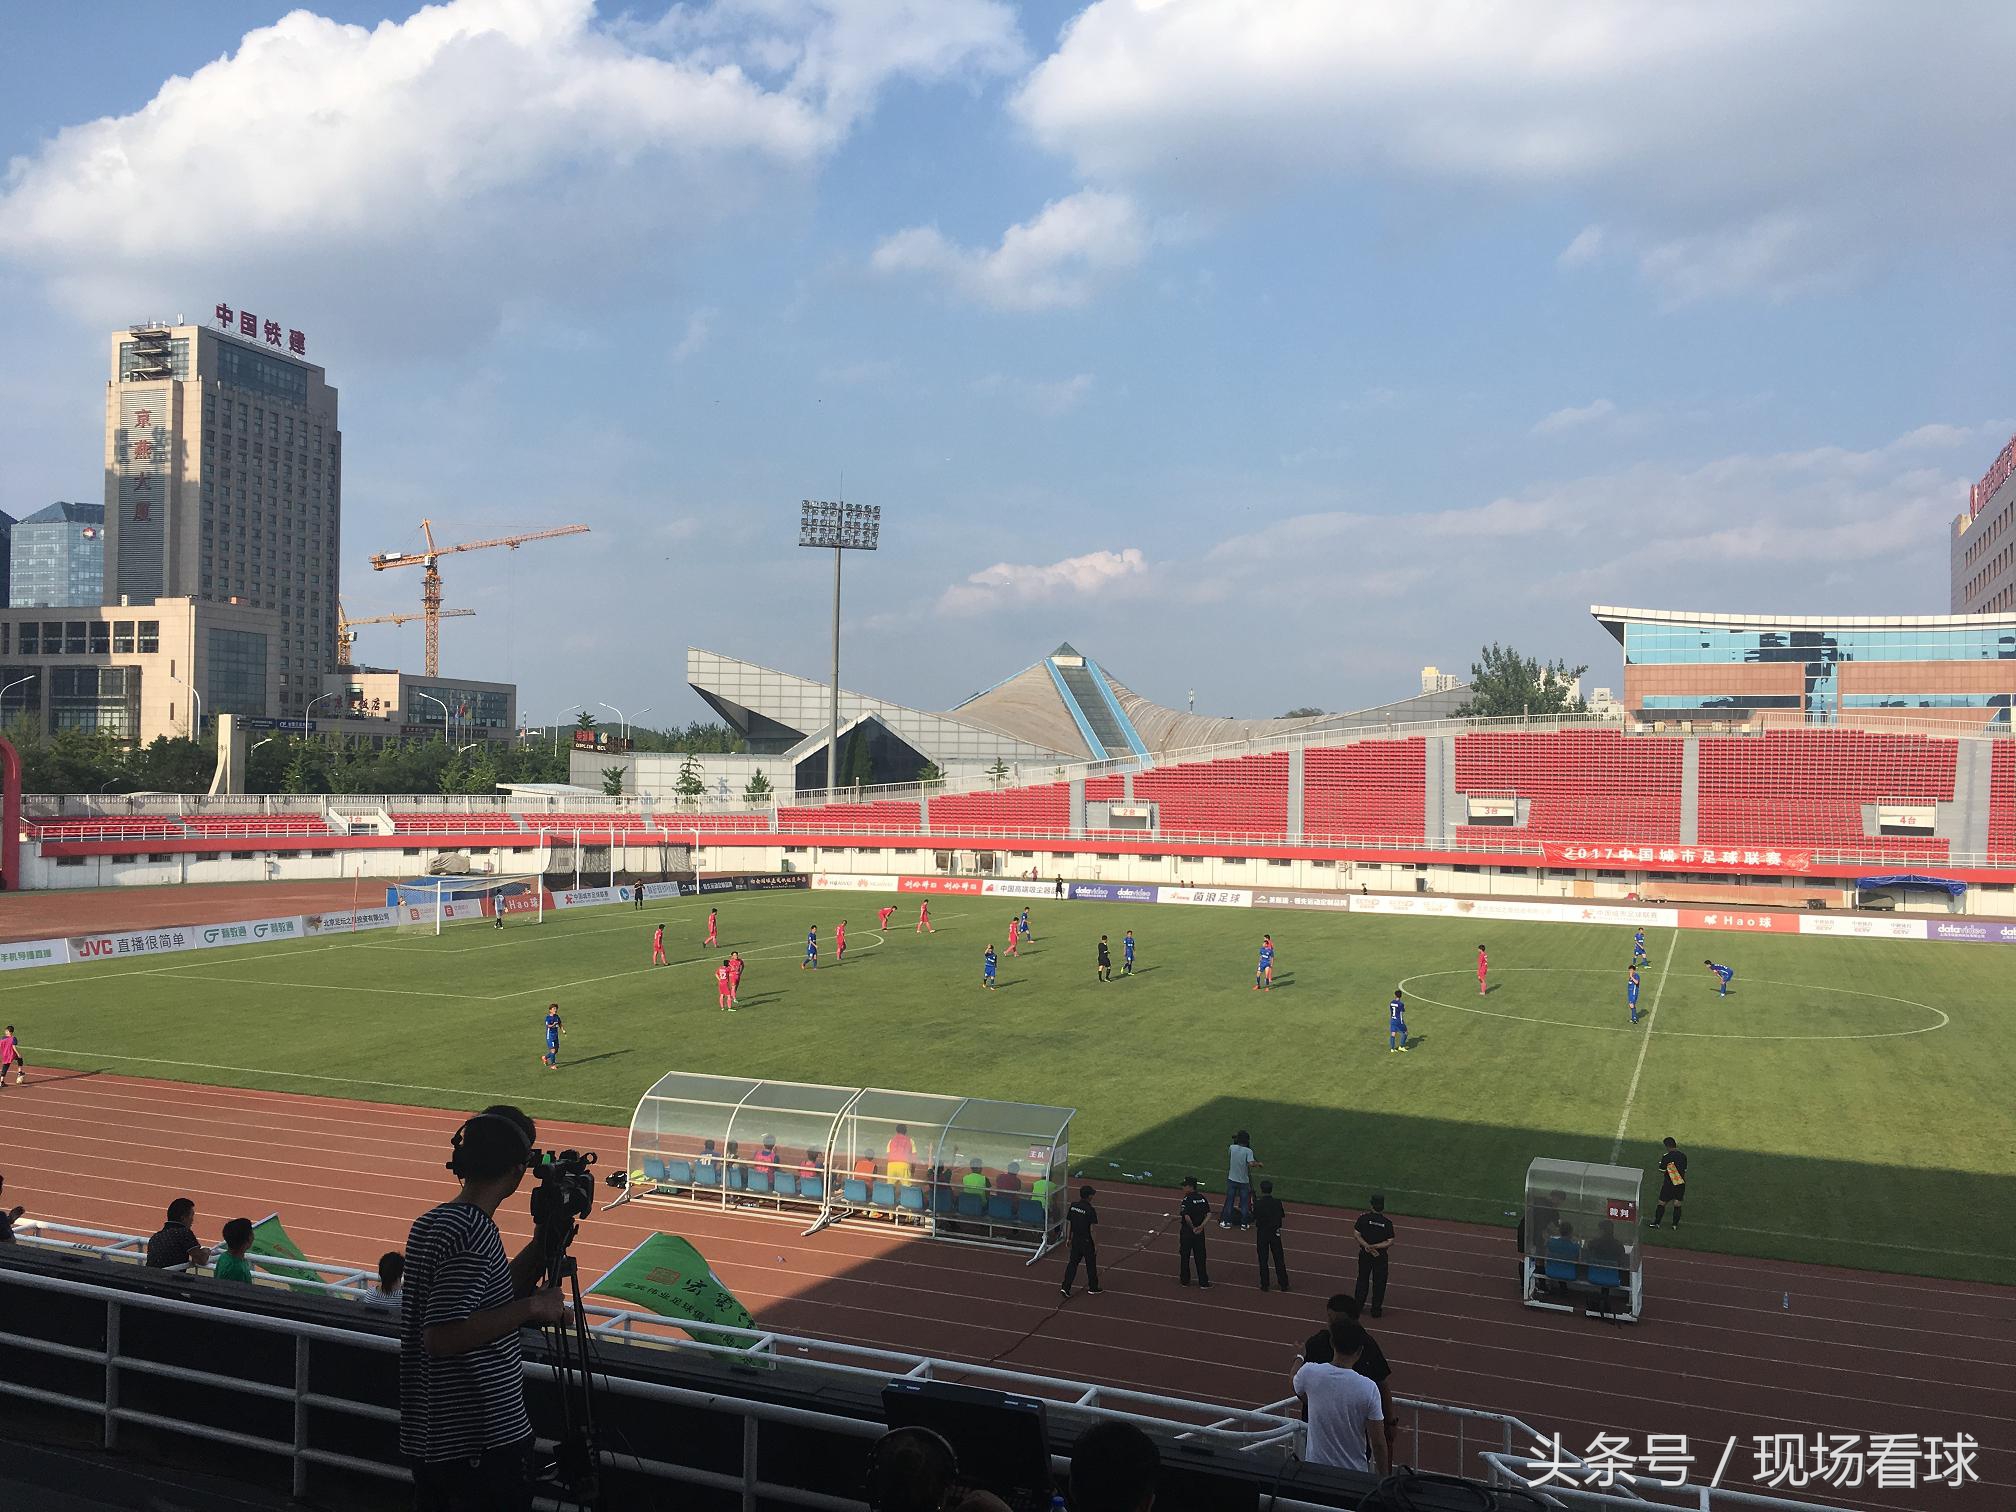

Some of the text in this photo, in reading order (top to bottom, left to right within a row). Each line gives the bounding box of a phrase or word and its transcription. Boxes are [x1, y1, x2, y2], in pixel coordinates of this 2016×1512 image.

[216, 303, 305, 355] 中国铁建
[133, 409, 152, 521] 京燕大厦
[1900, 816, 1917, 825] 4台
[1564, 847, 1782, 866] 2017中国城市足球联赛
[1075, 886, 1108, 895] datavideo
[1117, 888, 1150, 896] datavideo
[1723, 915, 1772, 928] Hao球
[1938, 924, 1986, 935] datavideo
[80, 940, 113, 957] JVC
[117, 933, 185, 953] 直播很简单
